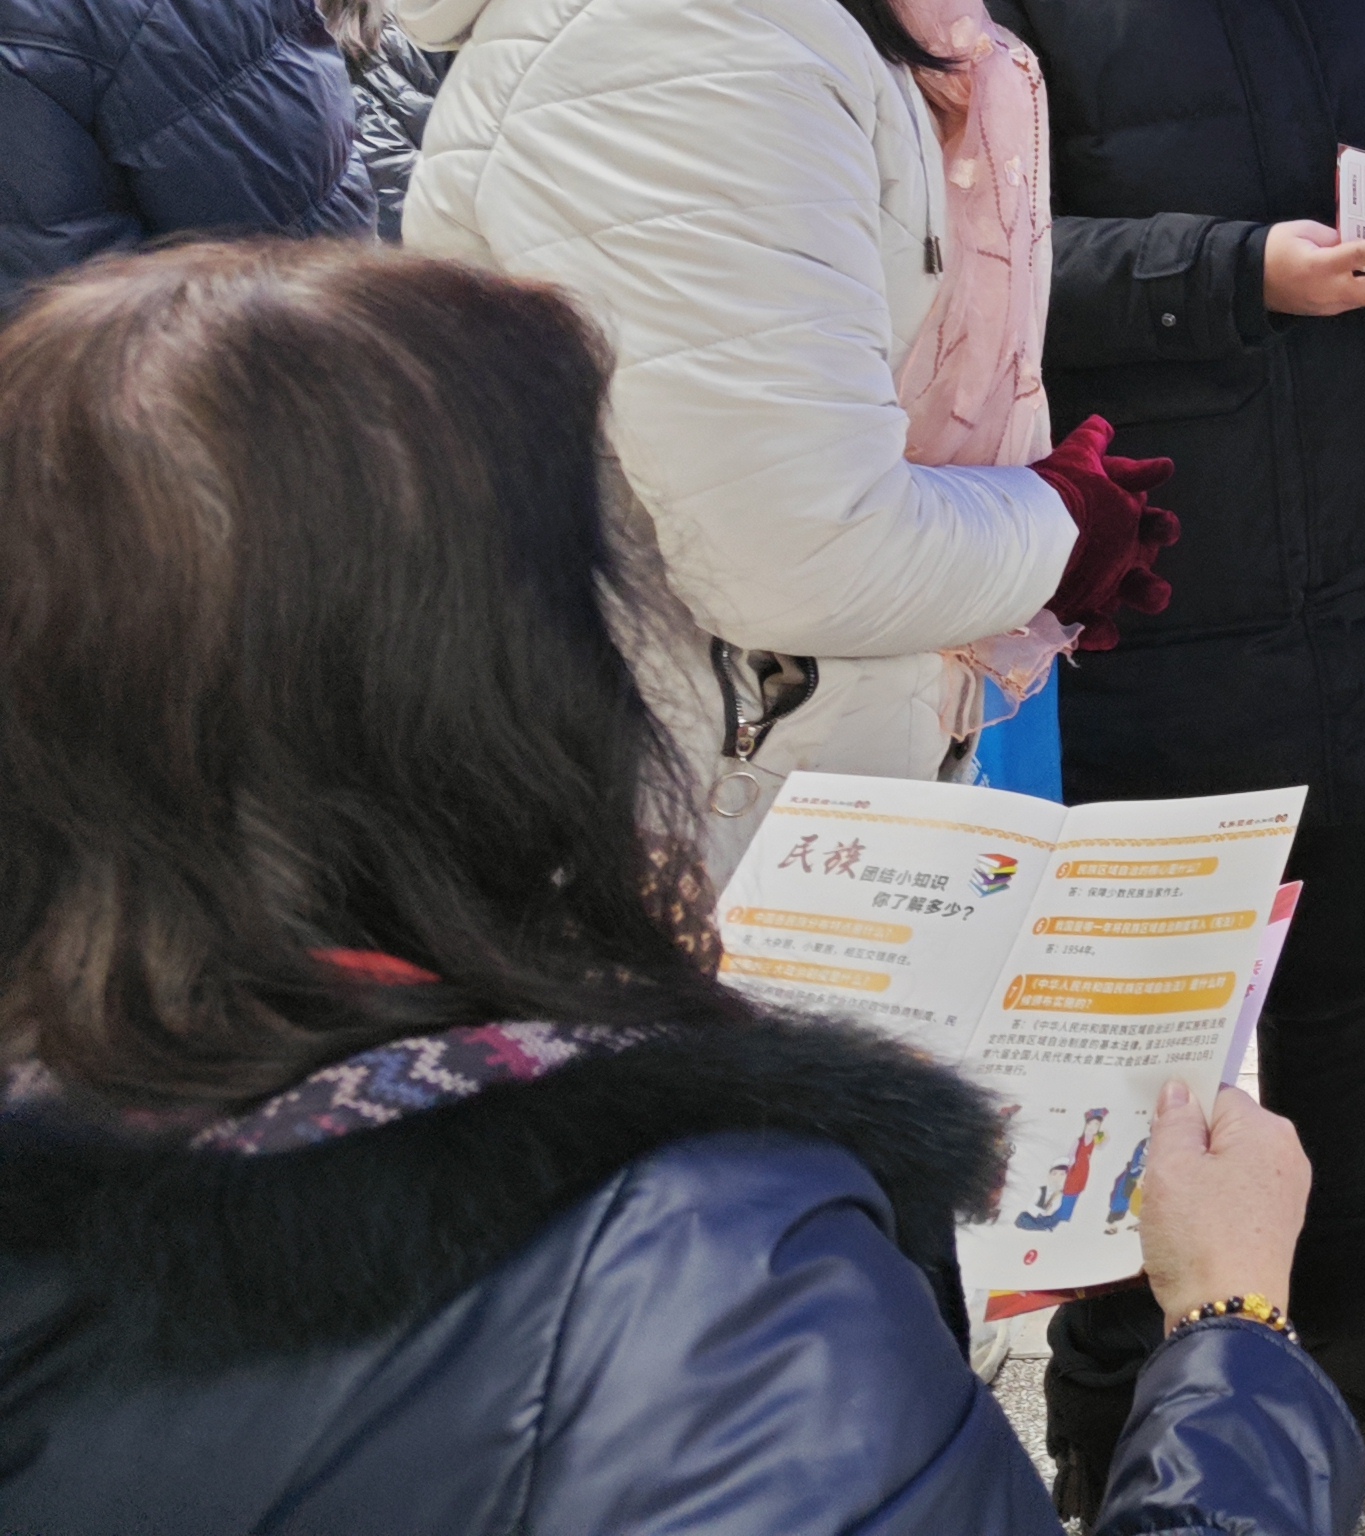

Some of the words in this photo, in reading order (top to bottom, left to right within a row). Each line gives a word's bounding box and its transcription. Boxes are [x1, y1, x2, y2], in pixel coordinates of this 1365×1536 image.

[778, 834, 867, 879] 民族
[860, 865, 949, 891] 团结小知识
